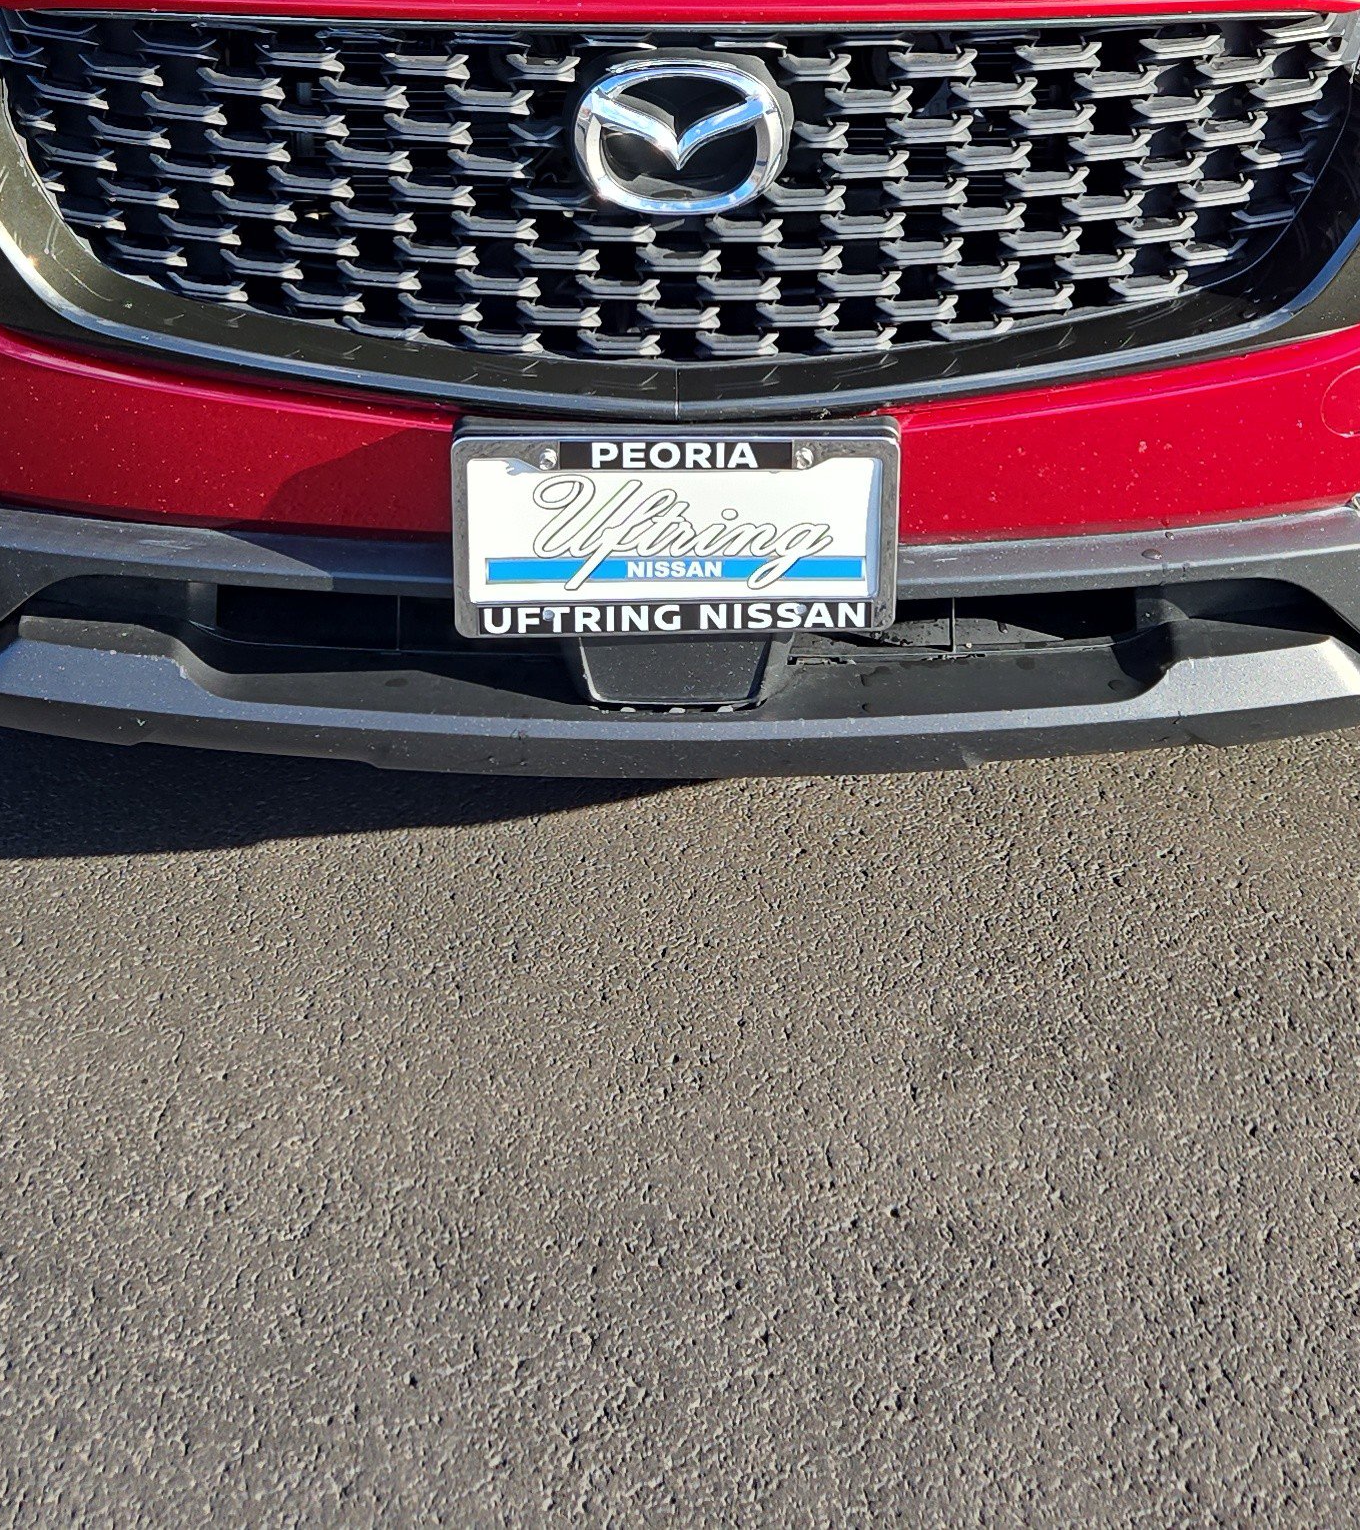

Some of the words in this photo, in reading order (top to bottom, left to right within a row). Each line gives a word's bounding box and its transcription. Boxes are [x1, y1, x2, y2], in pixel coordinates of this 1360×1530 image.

[590, 441, 759, 469] PEORIA
[532, 473, 834, 591] Uftring
[626, 560, 723, 579] NISSAN
[482, 604, 682, 635] UFTRING
[698, 602, 867, 631] NISSAN
